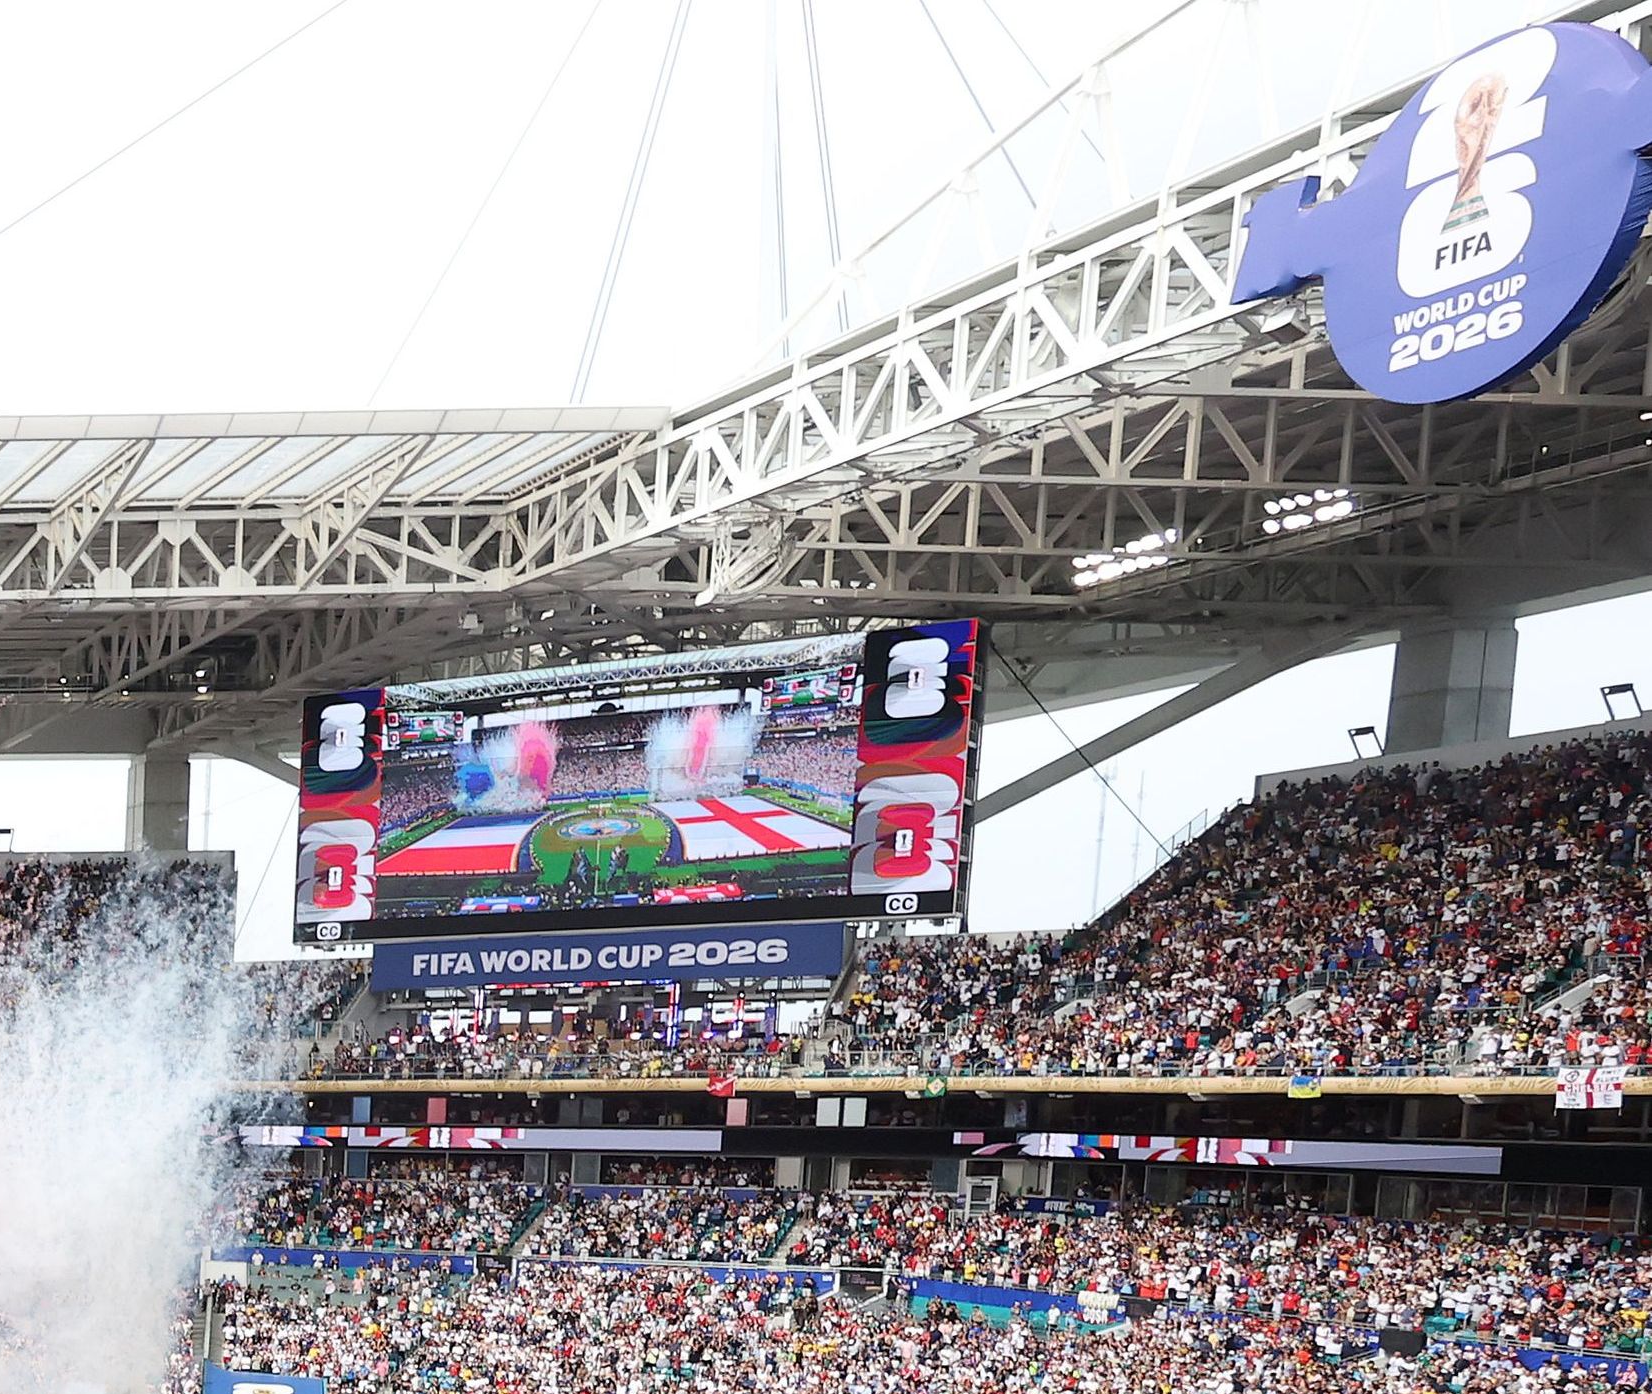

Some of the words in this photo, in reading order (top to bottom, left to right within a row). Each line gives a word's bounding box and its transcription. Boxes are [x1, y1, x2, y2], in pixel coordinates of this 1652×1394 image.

[1434, 231, 1493, 271] FIFA
[1393, 290, 1474, 336] WORLD
[1478, 274, 1528, 309] CUP
[1388, 301, 1524, 373] 2026
[889, 896, 915, 912] CC
[319, 925, 339, 938] CC
[413, 951, 475, 976] FIFA
[480, 945, 592, 973] WORLD
[597, 942, 663, 968] CUP
[669, 938, 789, 966] 2026
